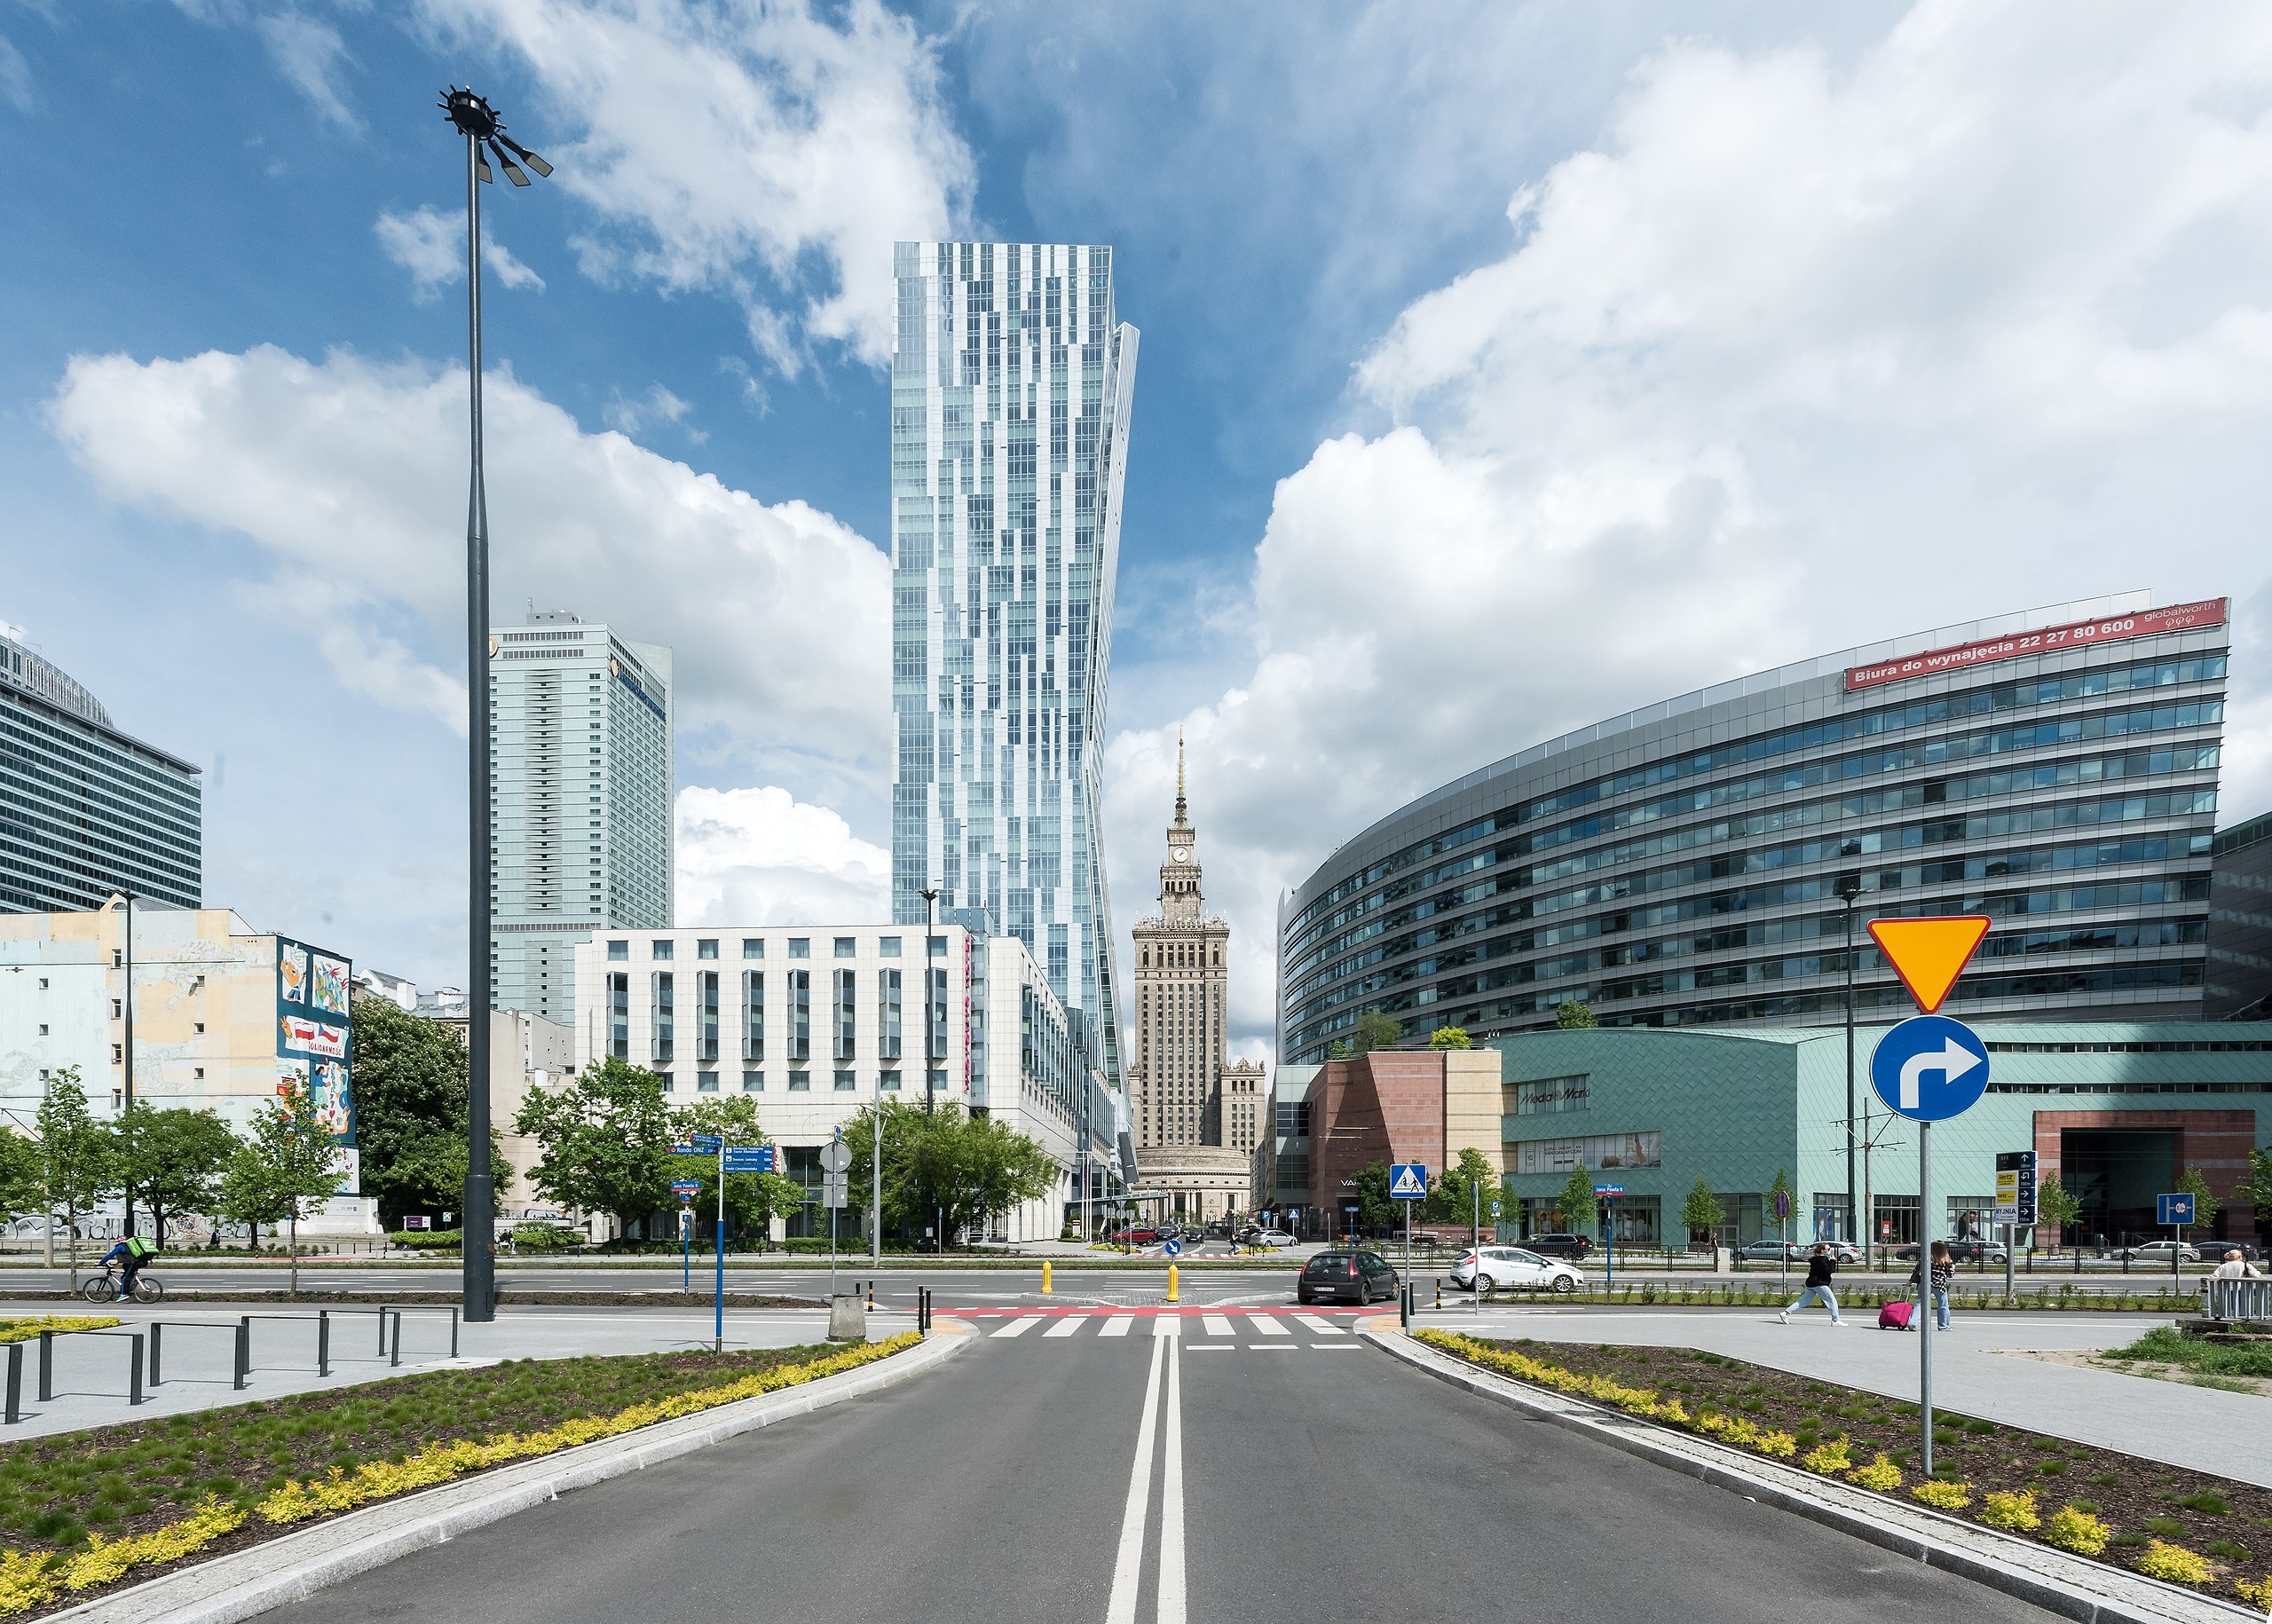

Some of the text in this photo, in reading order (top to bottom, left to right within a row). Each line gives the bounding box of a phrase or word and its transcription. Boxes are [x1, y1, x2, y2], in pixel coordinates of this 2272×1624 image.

[2144, 602, 2216, 622] globalworth
[1854, 619, 2134, 682] Biura do wynajęcia 22 27 80 600
